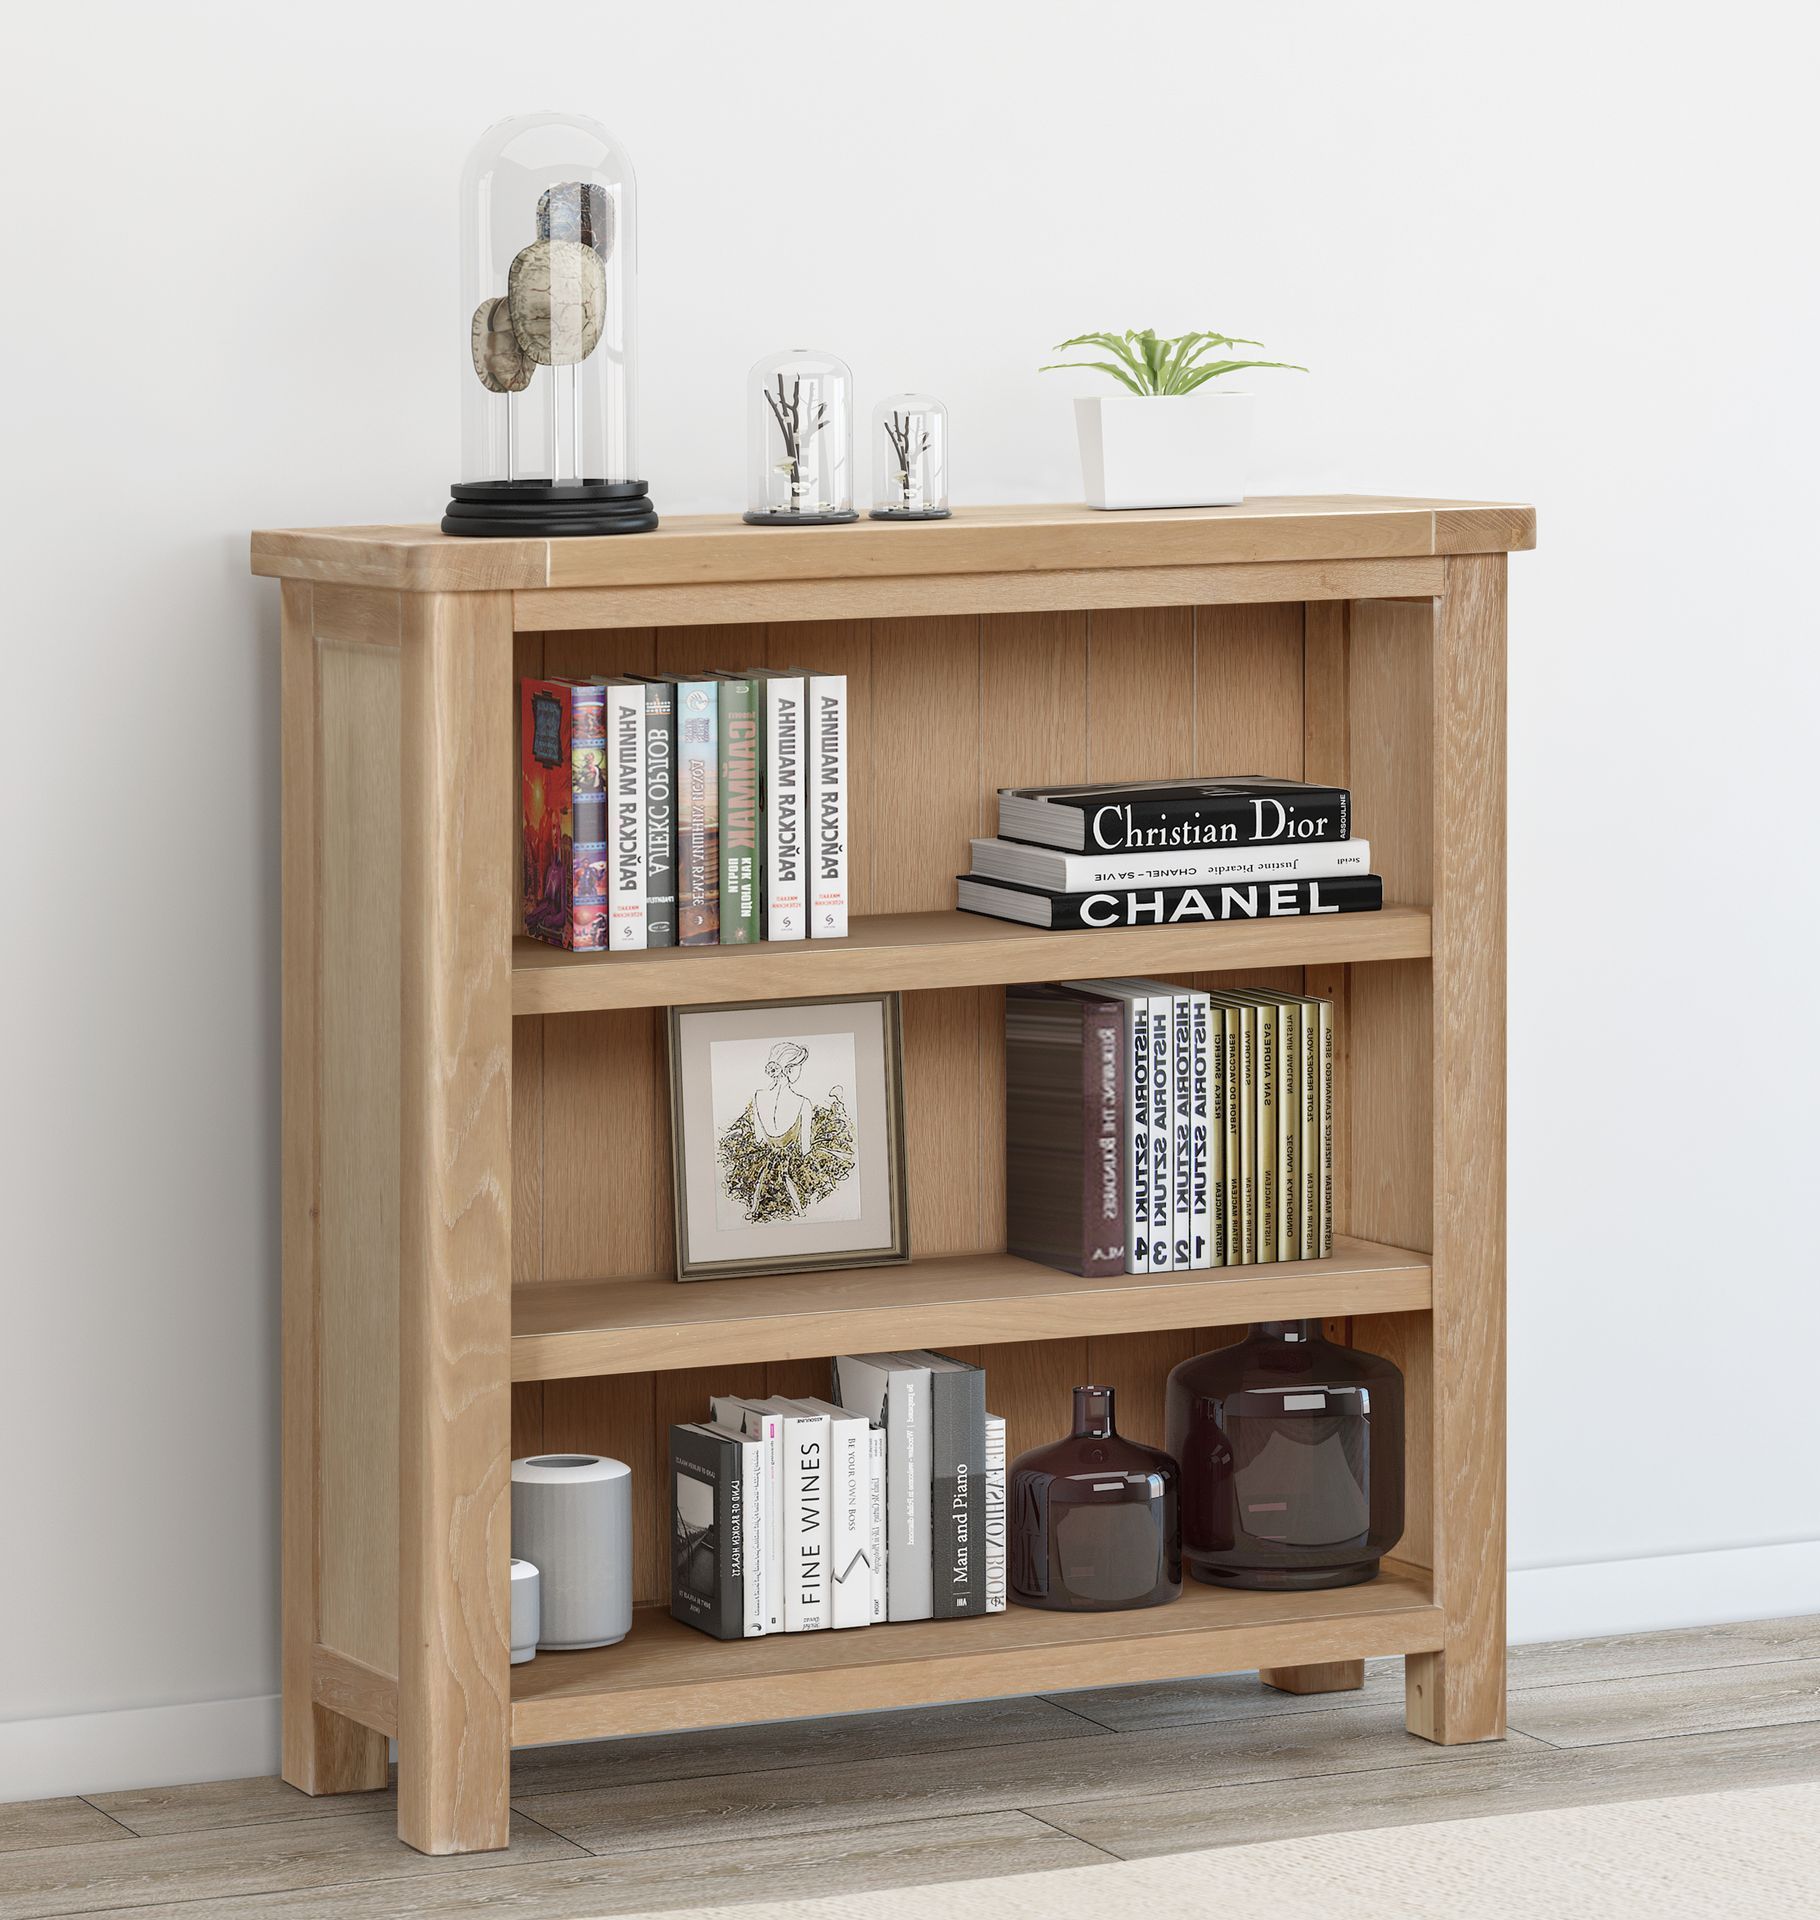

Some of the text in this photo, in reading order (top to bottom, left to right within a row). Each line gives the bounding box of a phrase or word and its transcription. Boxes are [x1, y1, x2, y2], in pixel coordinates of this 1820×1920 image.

[1092, 798, 1329, 850] Christian Dior
[1094, 873, 1116, 881] VIE
[1146, 867, 1198, 878] CHANEL
[1208, 858, 1299, 874] Justine Picardie
[1337, 857, 1361, 865] Steidl
[1079, 881, 1340, 928] CHANEL
[802, 1442, 820, 1532] WINES
[848, 1479, 857, 1505] OWN
[952, 1464, 968, 1583] Man and Piano
[802, 1544, 820, 1605] FINE
